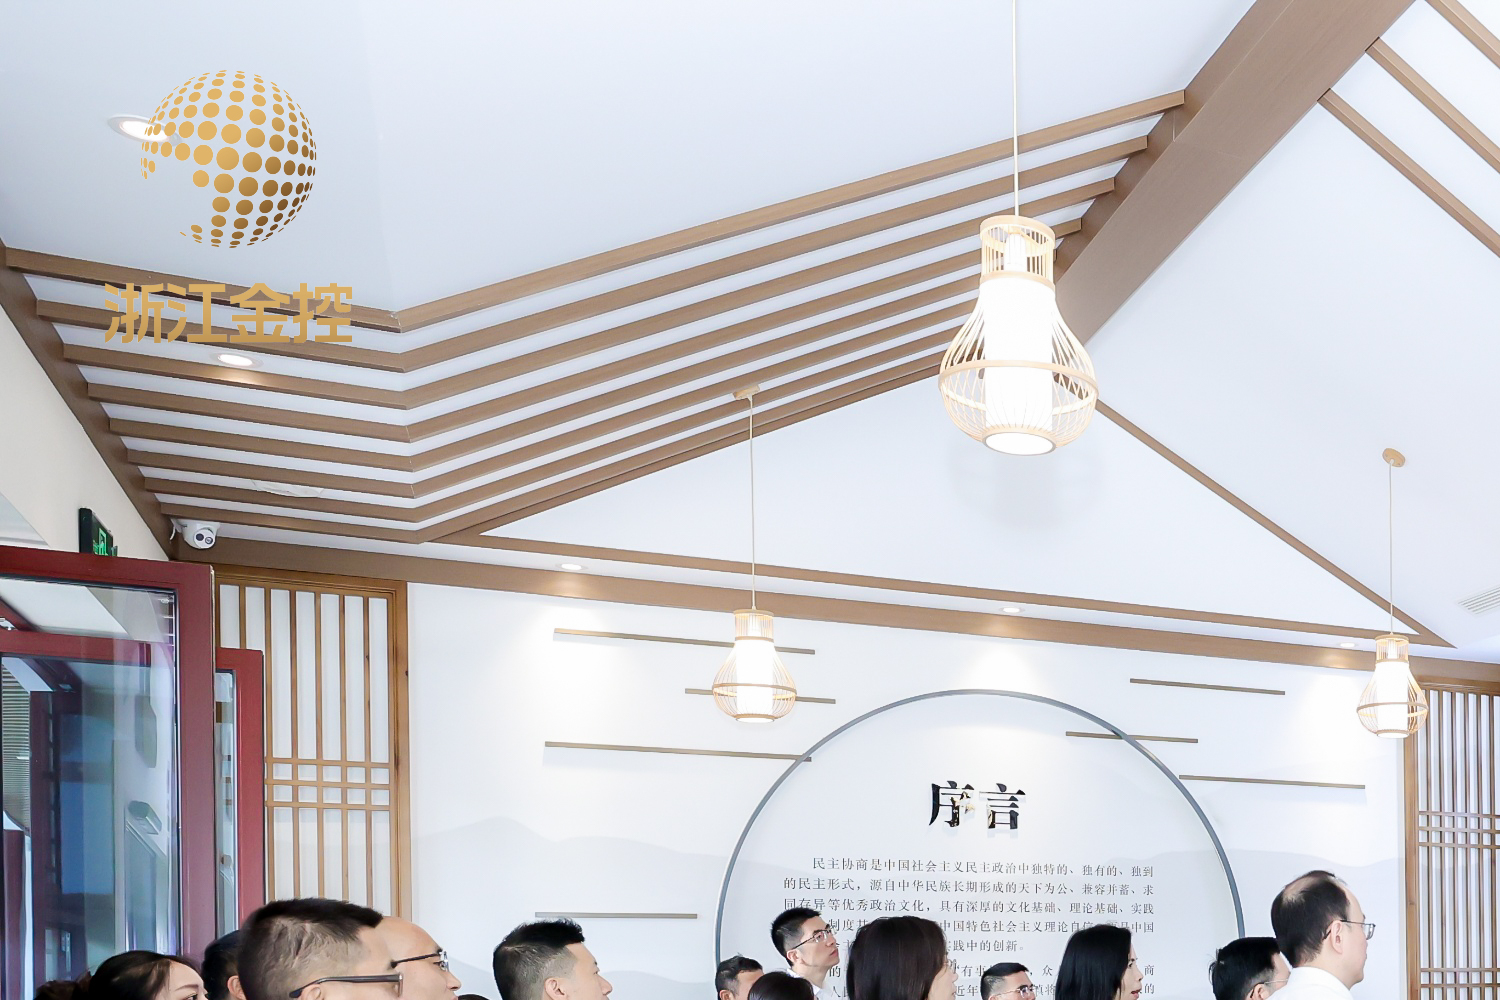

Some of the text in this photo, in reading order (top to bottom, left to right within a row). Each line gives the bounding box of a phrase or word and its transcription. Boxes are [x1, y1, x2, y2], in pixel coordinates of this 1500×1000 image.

[929, 780, 1026, 830] 序言
[812, 857, 1154, 878] 民主协商是中国社会主义民主政治中独特的、独有的、独到
[783, 877, 1155, 896] 的民主形式，源自中华民族长期形成的天下为公、兼容并蓄、求
